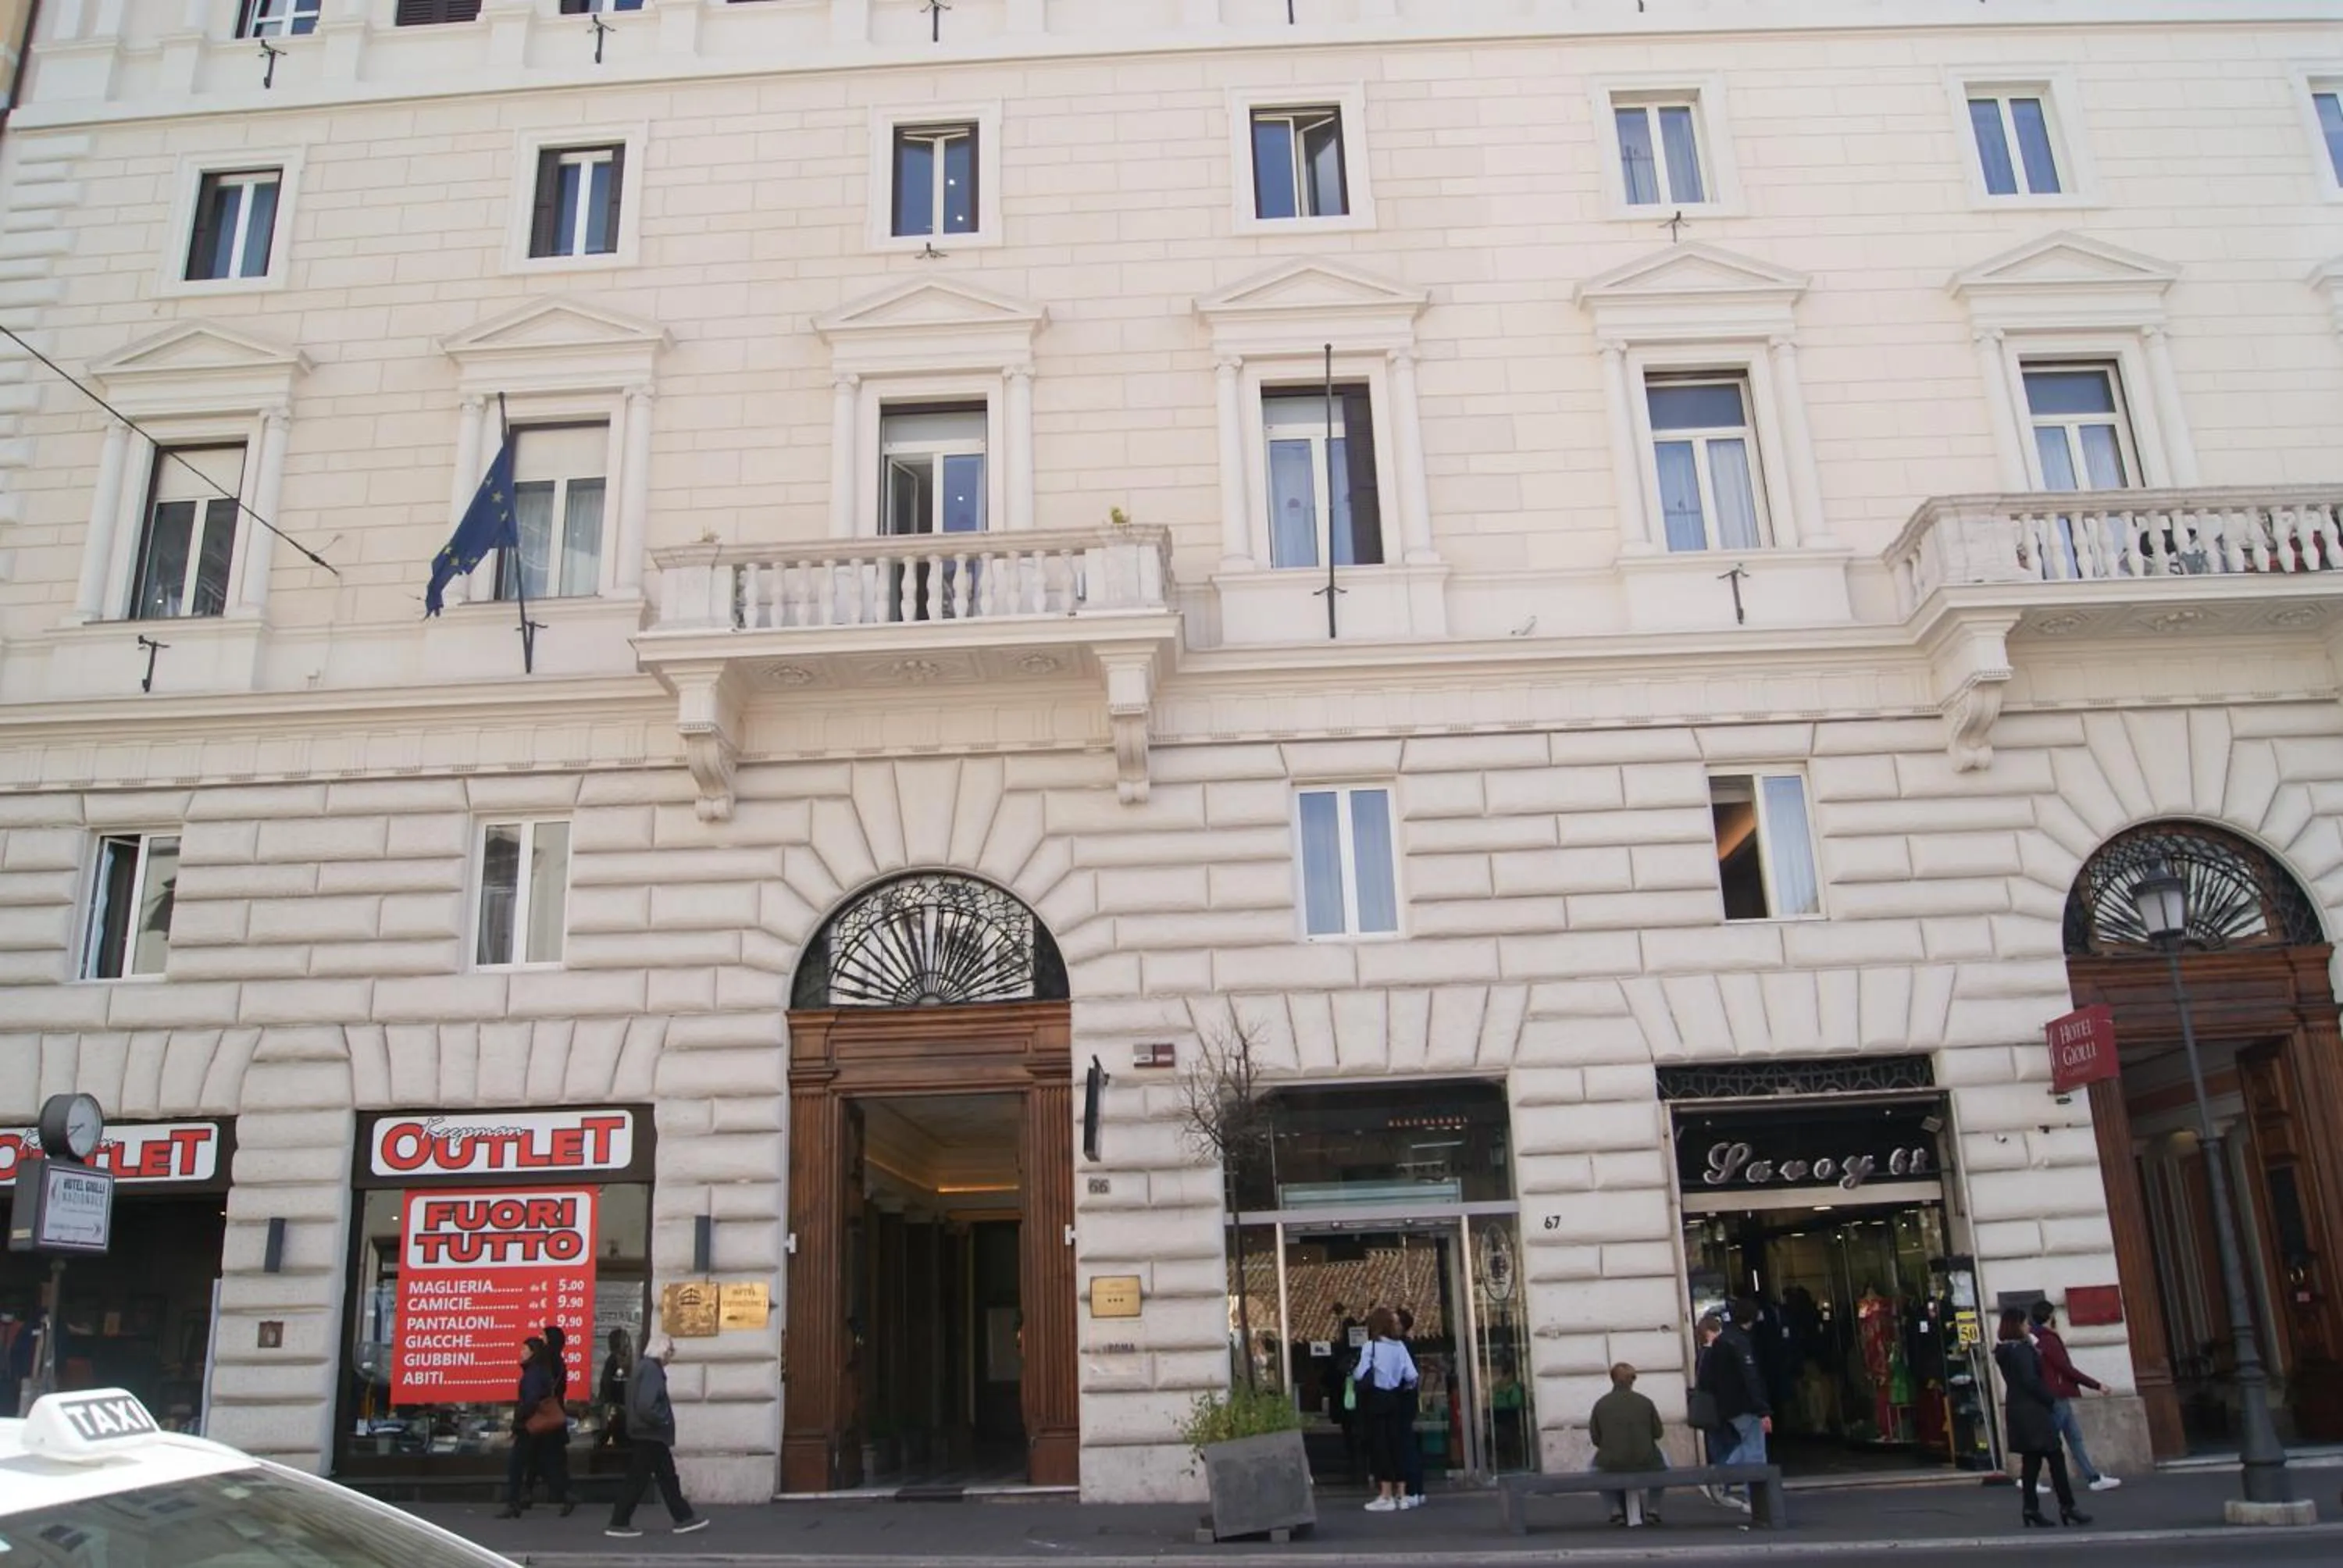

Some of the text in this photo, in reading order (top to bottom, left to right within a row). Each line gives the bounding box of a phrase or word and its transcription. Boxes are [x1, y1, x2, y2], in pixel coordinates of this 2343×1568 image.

[2059, 1018, 2091, 1045] HOTEL
[380, 1116, 626, 1171] OUTLET
[1703, 1142, 1875, 1190] Savoy
[424, 1198, 576, 1231] FUORI
[1544, 1215, 1561, 1230] 67
[415, 1229, 583, 1263] TUTTO
[62, 1399, 151, 1436] TAXI
